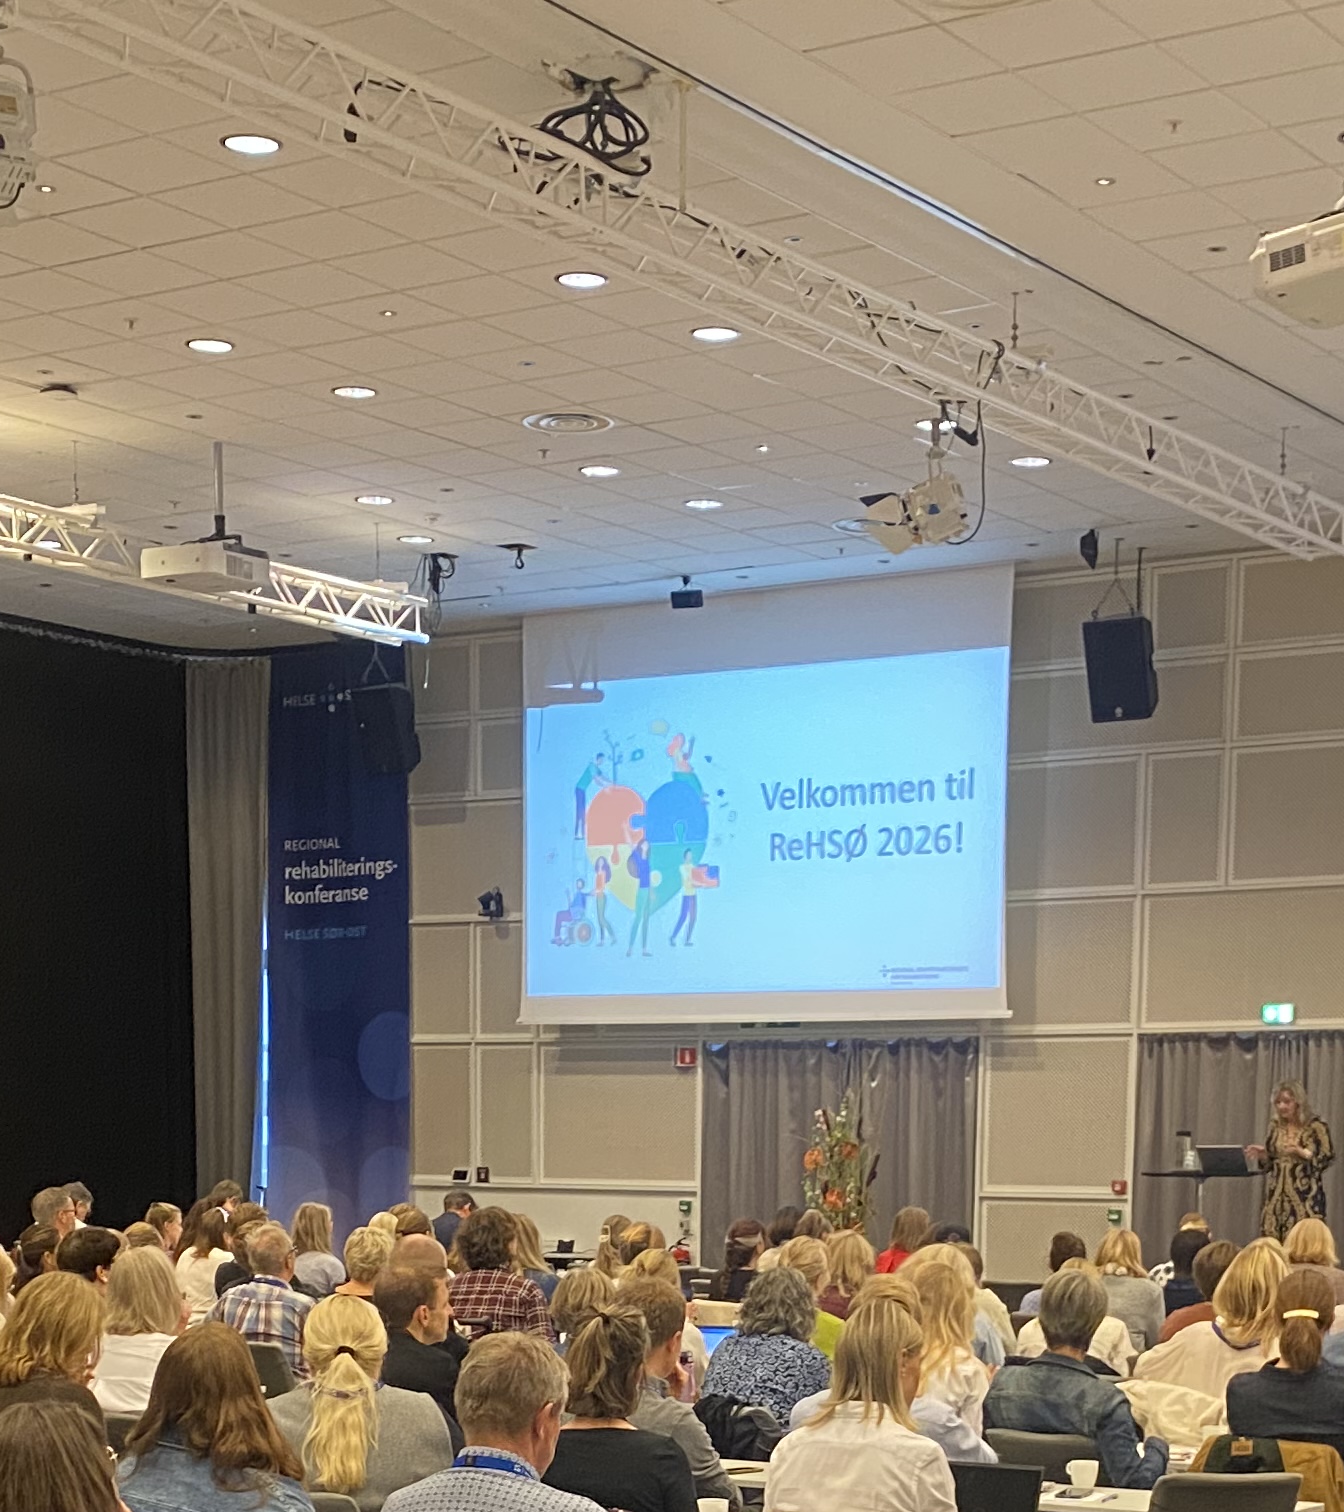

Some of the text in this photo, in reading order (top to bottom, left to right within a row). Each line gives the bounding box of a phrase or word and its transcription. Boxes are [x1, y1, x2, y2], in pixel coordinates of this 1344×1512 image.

[760, 767, 976, 811] Velkommen til
[284, 838, 341, 851] REGIONAL
[769, 821, 964, 863] ReHSØ 2026!
[285, 856, 398, 880] rehabiliterings-
[284, 884, 369, 904] konferanse
